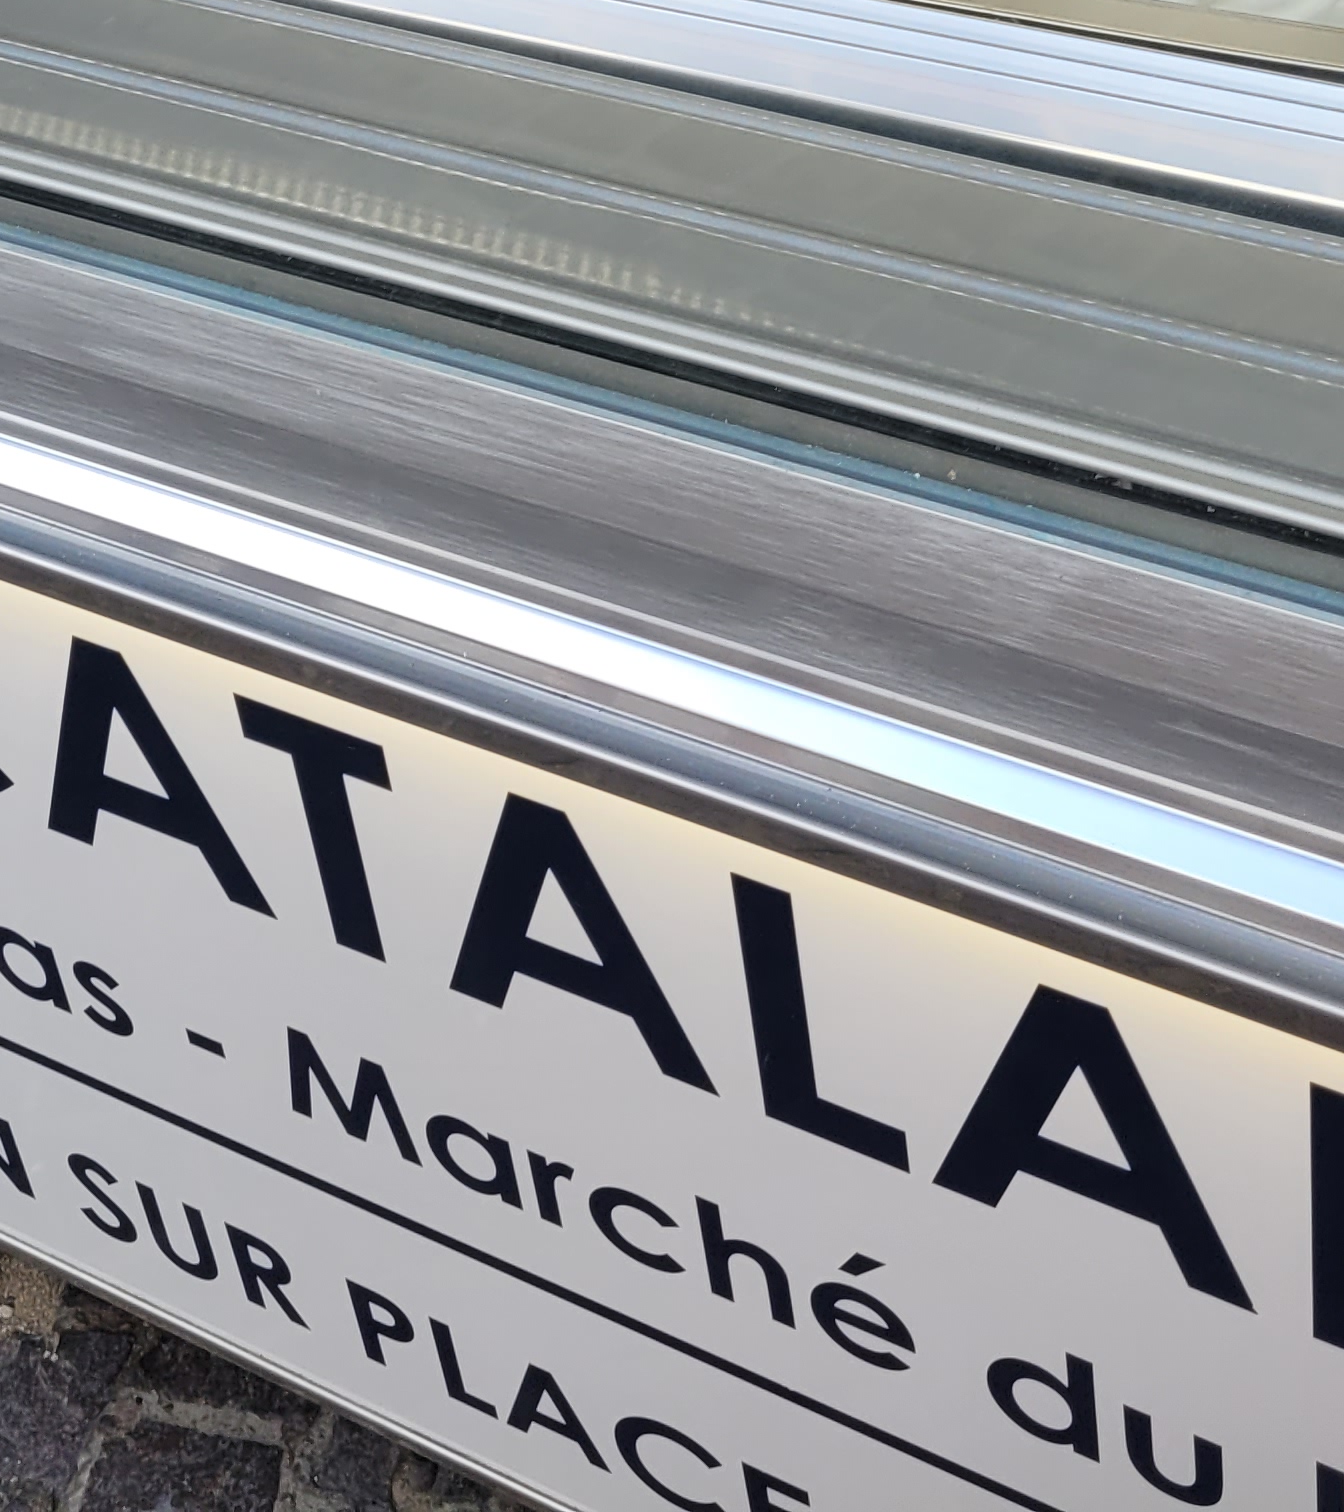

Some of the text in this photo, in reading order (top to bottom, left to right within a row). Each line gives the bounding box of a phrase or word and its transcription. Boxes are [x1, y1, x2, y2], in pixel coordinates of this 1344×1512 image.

[67, 1153, 312, 1331] SUR
[286, 1025, 918, 1372] Marché
[986, 1351, 1225, 1508] du
